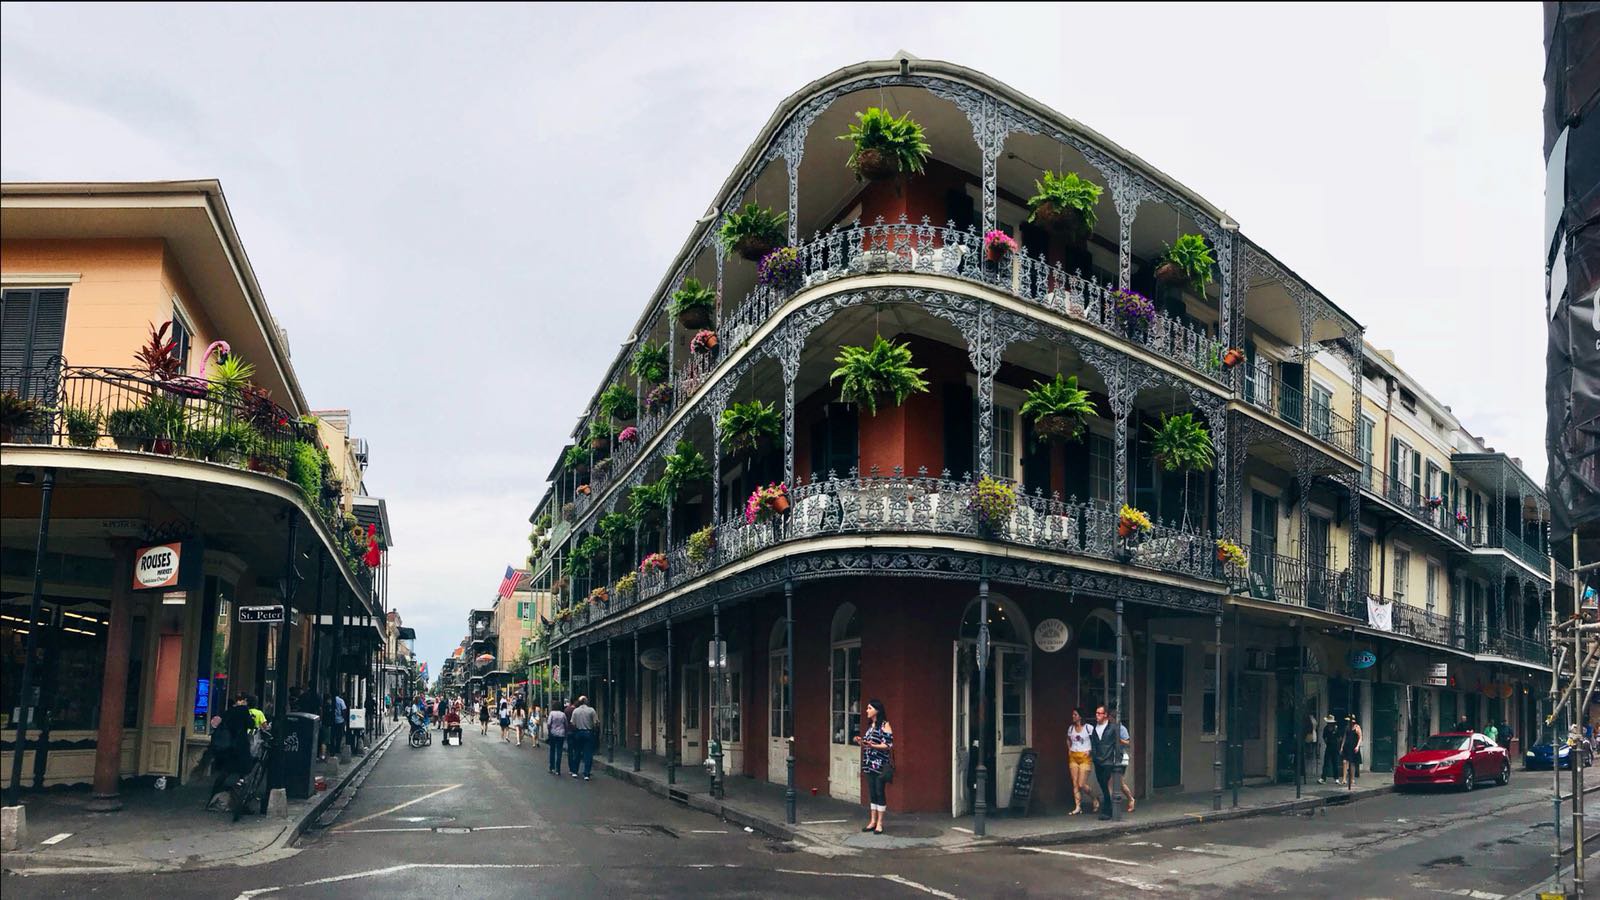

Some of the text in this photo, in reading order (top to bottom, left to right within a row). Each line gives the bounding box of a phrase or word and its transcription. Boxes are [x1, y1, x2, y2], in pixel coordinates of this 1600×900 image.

[140, 552, 171, 571] ROUSES
[157, 567, 172, 575] MARKET
[241, 611, 281, 619] St. Peter
